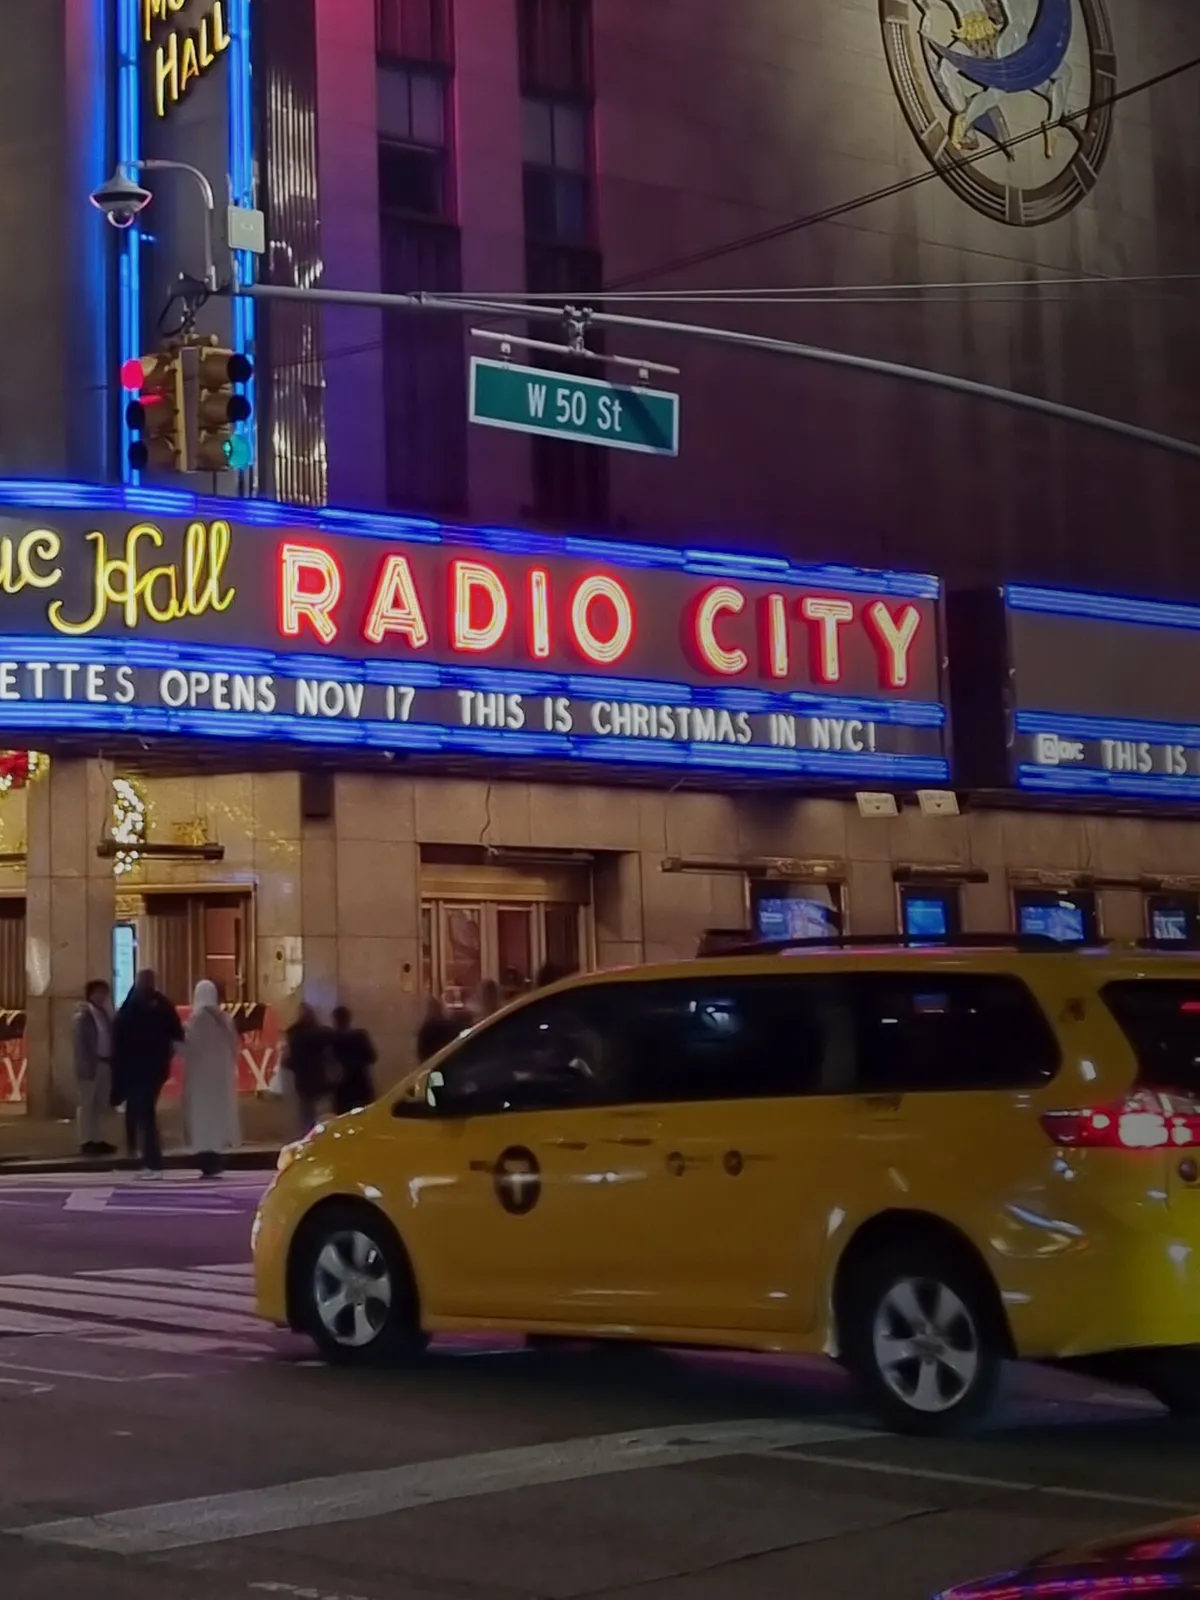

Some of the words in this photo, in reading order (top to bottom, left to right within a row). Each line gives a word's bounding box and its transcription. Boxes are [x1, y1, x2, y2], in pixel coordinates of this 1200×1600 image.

[155, 1, 231, 116] HALL
[527, 382, 547, 418] W
[556, 388, 586, 425] 50
[597, 396, 622, 431] St
[48, 520, 235, 634] Hall
[279, 542, 633, 663] RADIO
[697, 587, 920, 686] CITY
[160, 672, 275, 712] OPENS
[297, 678, 364, 718] NOV
[386, 687, 414, 721] 17
[458, 690, 524, 728] THIS
[544, 697, 572, 732] IS
[590, 701, 751, 745] CHRISTMAS
[770, 713, 796, 747] IN
[812, 718, 876, 752] NYC!
[1102, 740, 1152, 773] THIS
[1165, 745, 1187, 775] IS
